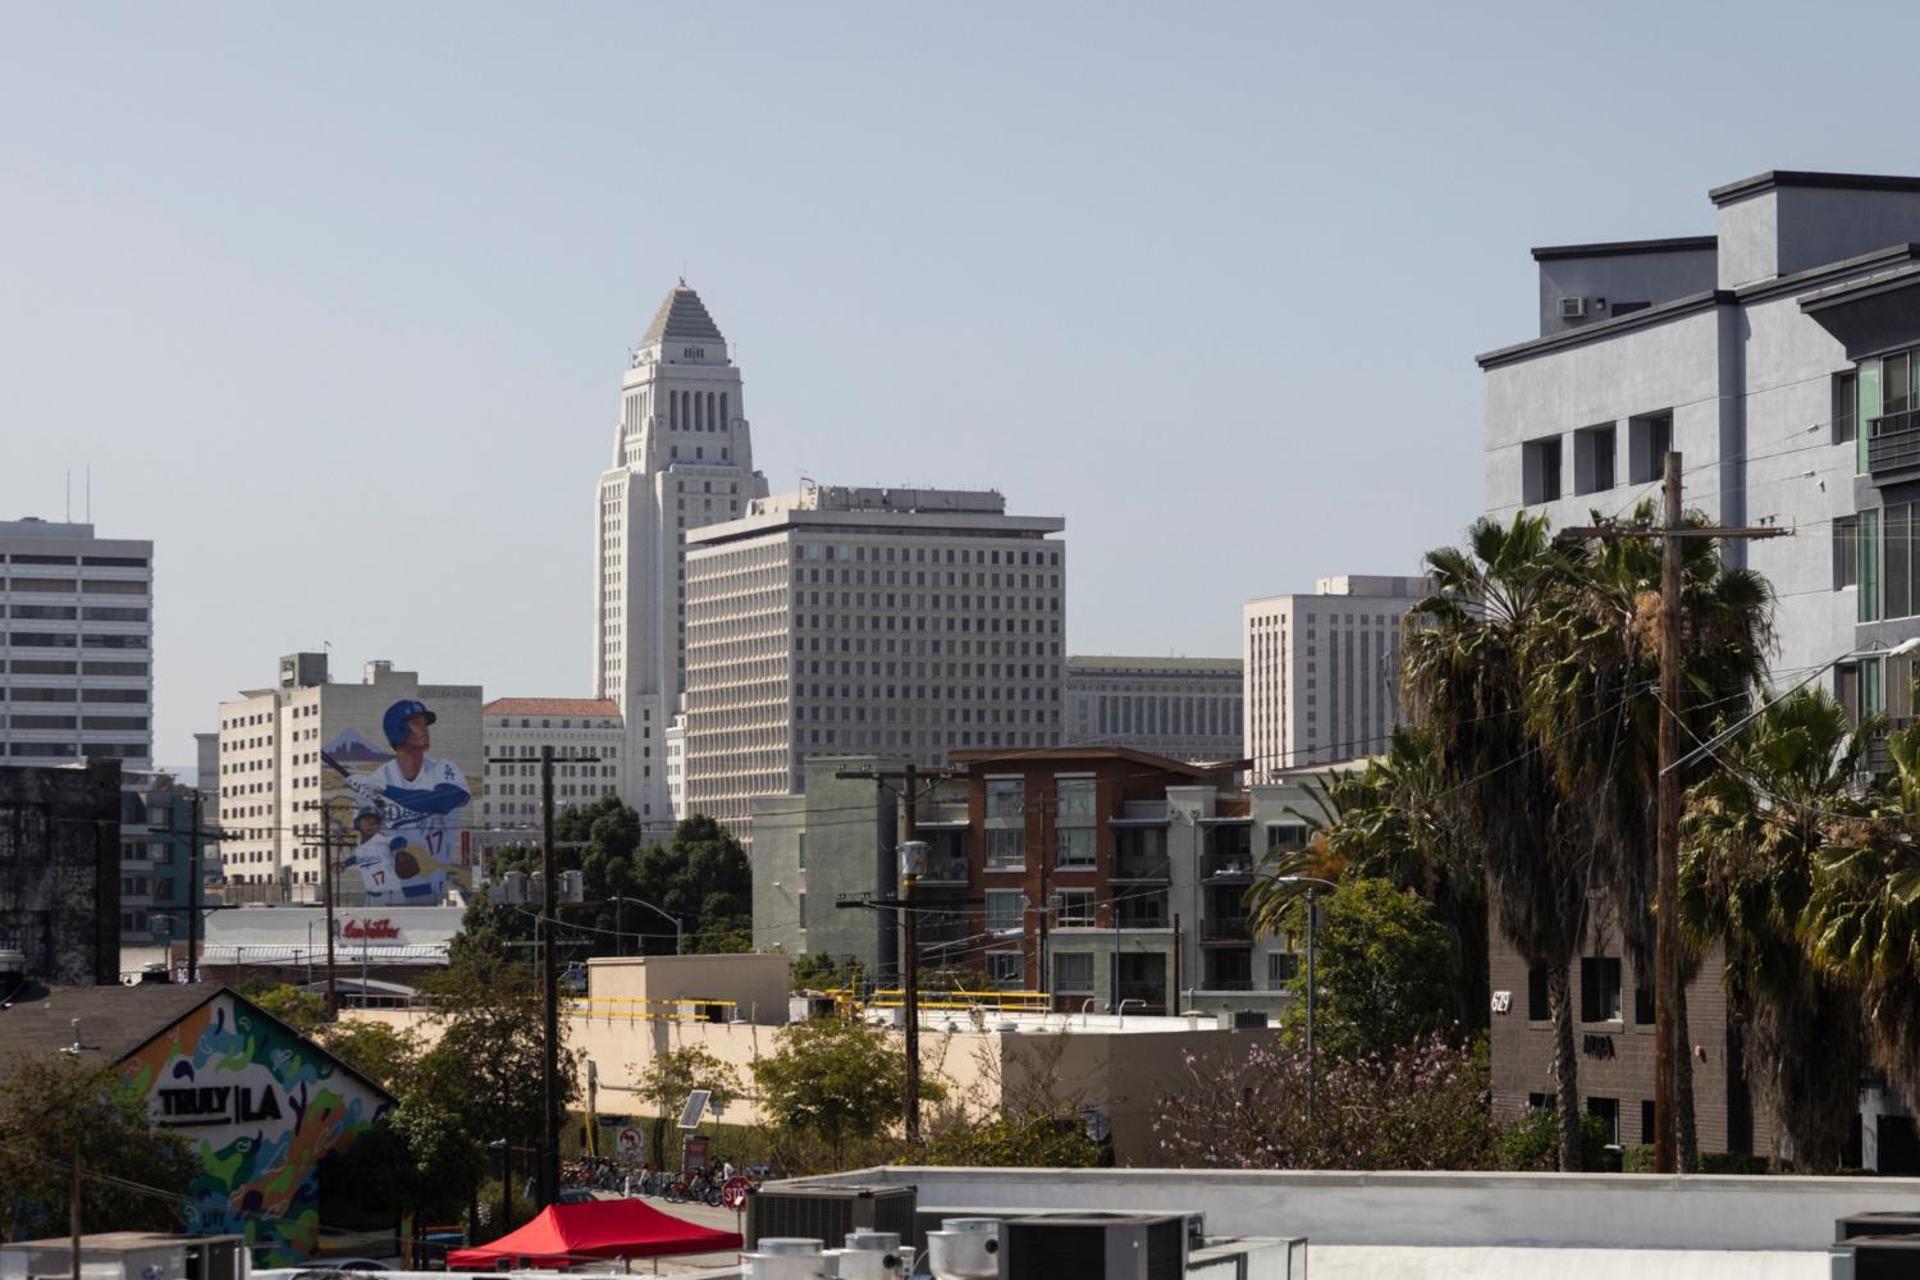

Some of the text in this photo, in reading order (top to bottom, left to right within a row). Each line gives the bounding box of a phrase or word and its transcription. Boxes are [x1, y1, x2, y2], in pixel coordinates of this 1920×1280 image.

[426, 830, 443, 857] 17
[372, 870, 385, 886] 17
[1491, 990, 1511, 1012] 629
[158, 1085, 282, 1122] TRULY LA
